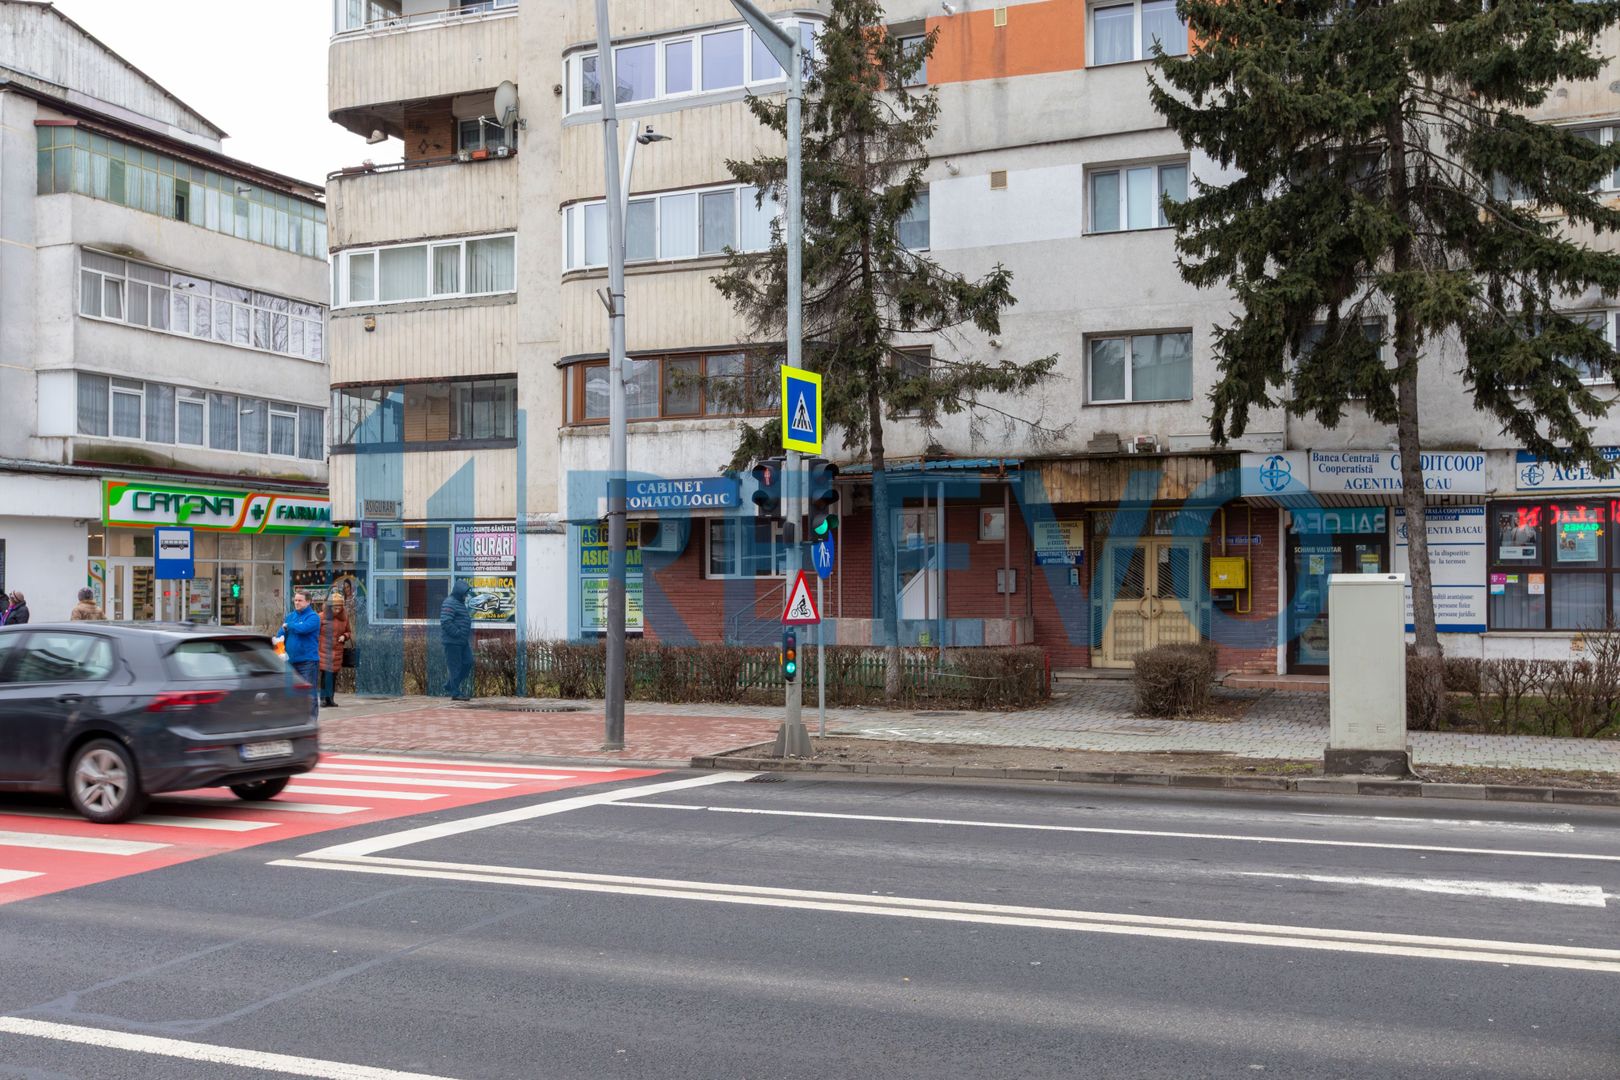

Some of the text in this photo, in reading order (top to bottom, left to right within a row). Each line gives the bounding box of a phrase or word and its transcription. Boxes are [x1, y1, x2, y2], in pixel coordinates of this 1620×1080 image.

[1312, 452, 1380, 463] Banca Centrală
[1390, 454, 1484, 472] CDITCOOP
[1318, 463, 1374, 476] Cooperatistă
[637, 480, 704, 495] CABINET
[132, 491, 235, 517] CATENA
[626, 493, 730, 508] OMATOLOGIC
[1427, 526, 1484, 535] ENTIA BACAU
[498, 577, 514, 588] RCA
